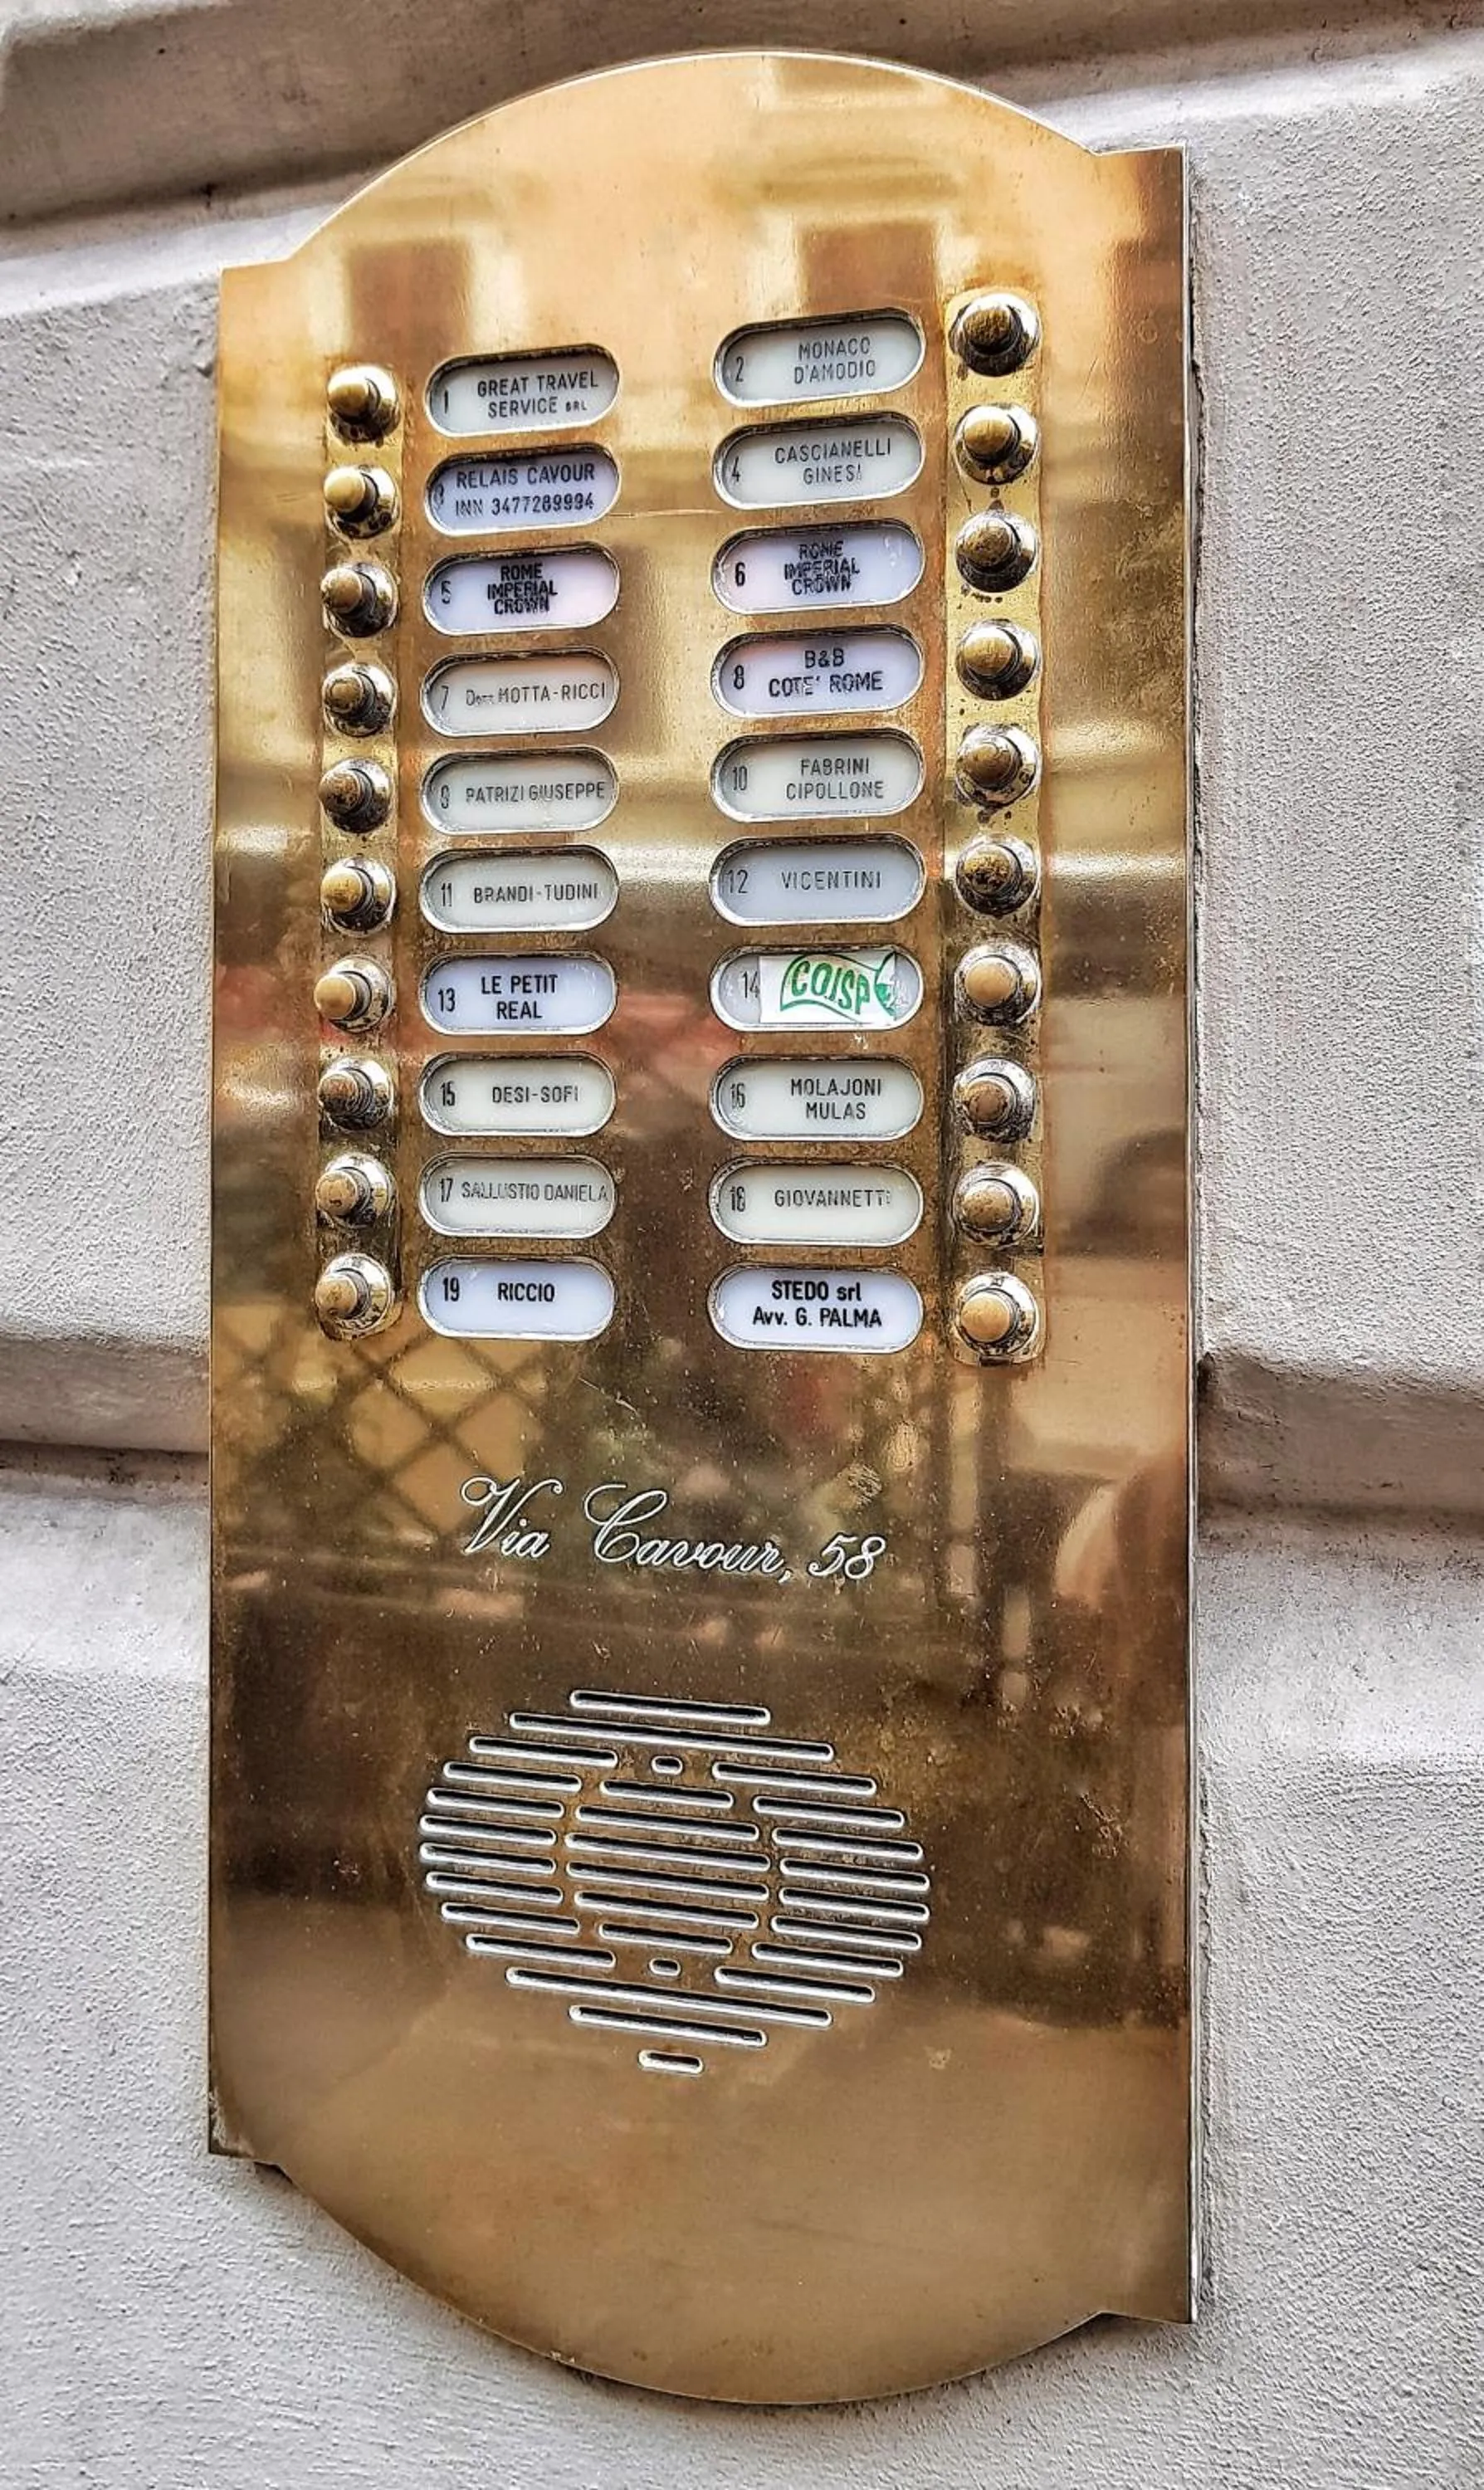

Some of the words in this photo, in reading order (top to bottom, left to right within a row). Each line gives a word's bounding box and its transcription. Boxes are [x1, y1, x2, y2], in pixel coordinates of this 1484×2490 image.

[798, 337, 871, 360] MONACO
[735, 357, 744, 382] 2
[794, 360, 875, 384] D'AMODIO
[477, 378, 528, 398] GREAT
[537, 370, 598, 392] TRAVEL
[444, 390, 449, 413] 1
[488, 397, 558, 418] SERVICE
[774, 438, 891, 464] CASCIANELLI
[456, 468, 518, 489] RELAIS
[527, 463, 595, 485] CAVOUR
[732, 456, 740, 481] 4
[803, 464, 862, 485] GINESI
[456, 500, 483, 518] INN
[798, 541, 844, 559] ROME
[500, 564, 543, 581] ROME
[735, 562, 745, 587] 6
[784, 558, 860, 580] IMPERIAL
[441, 581, 452, 604] 5
[487, 581, 558, 600] IMPERIAL
[792, 574, 852, 595] CROWN
[494, 598, 549, 615] CROWN
[805, 648, 844, 668] B&B
[734, 666, 744, 689] 8
[769, 675, 821, 697] COTE'
[829, 671, 883, 693] ROME
[441, 685, 449, 710] 7
[498, 682, 605, 703] MOTTA-RICCI
[732, 765, 747, 791] 10
[801, 757, 869, 777] FABRINI
[466, 785, 524, 804] PATRIZI
[529, 781, 605, 801] GIUSEPPE
[787, 780, 884, 800] CIPOLLONE
[728, 869, 748, 894] 12
[781, 871, 881, 891] VICENTINI
[442, 882, 452, 907] 11
[481, 976, 502, 994] LE
[510, 974, 558, 994] PETIT
[742, 971, 759, 998] 14
[438, 988, 456, 1012] 13
[497, 1001, 543, 1019] REAL
[441, 1081, 456, 1106] 15
[492, 1086, 578, 1104] DESI-SOFI
[730, 1083, 745, 1108] 16
[791, 1078, 881, 1096] MOLAJONI
[806, 1101, 866, 1120] MULAS
[439, 1178, 453, 1202] 17
[461, 1181, 540, 1200] SALLUSTIO
[544, 1184, 608, 1202] DANIELA
[443, 1277, 460, 1302] 19
[498, 1282, 555, 1302] RICCIO
[772, 1280, 828, 1301] STEDO
[837, 1282, 862, 1301] srl
[752, 1306, 787, 1326] Avv.
[796, 1307, 812, 1326] G.
[820, 1308, 882, 1328] PALMA
[460, 1476, 564, 1557] Via
[583, 1483, 793, 1584] Cavour,
[808, 1533, 886, 1580] 58
